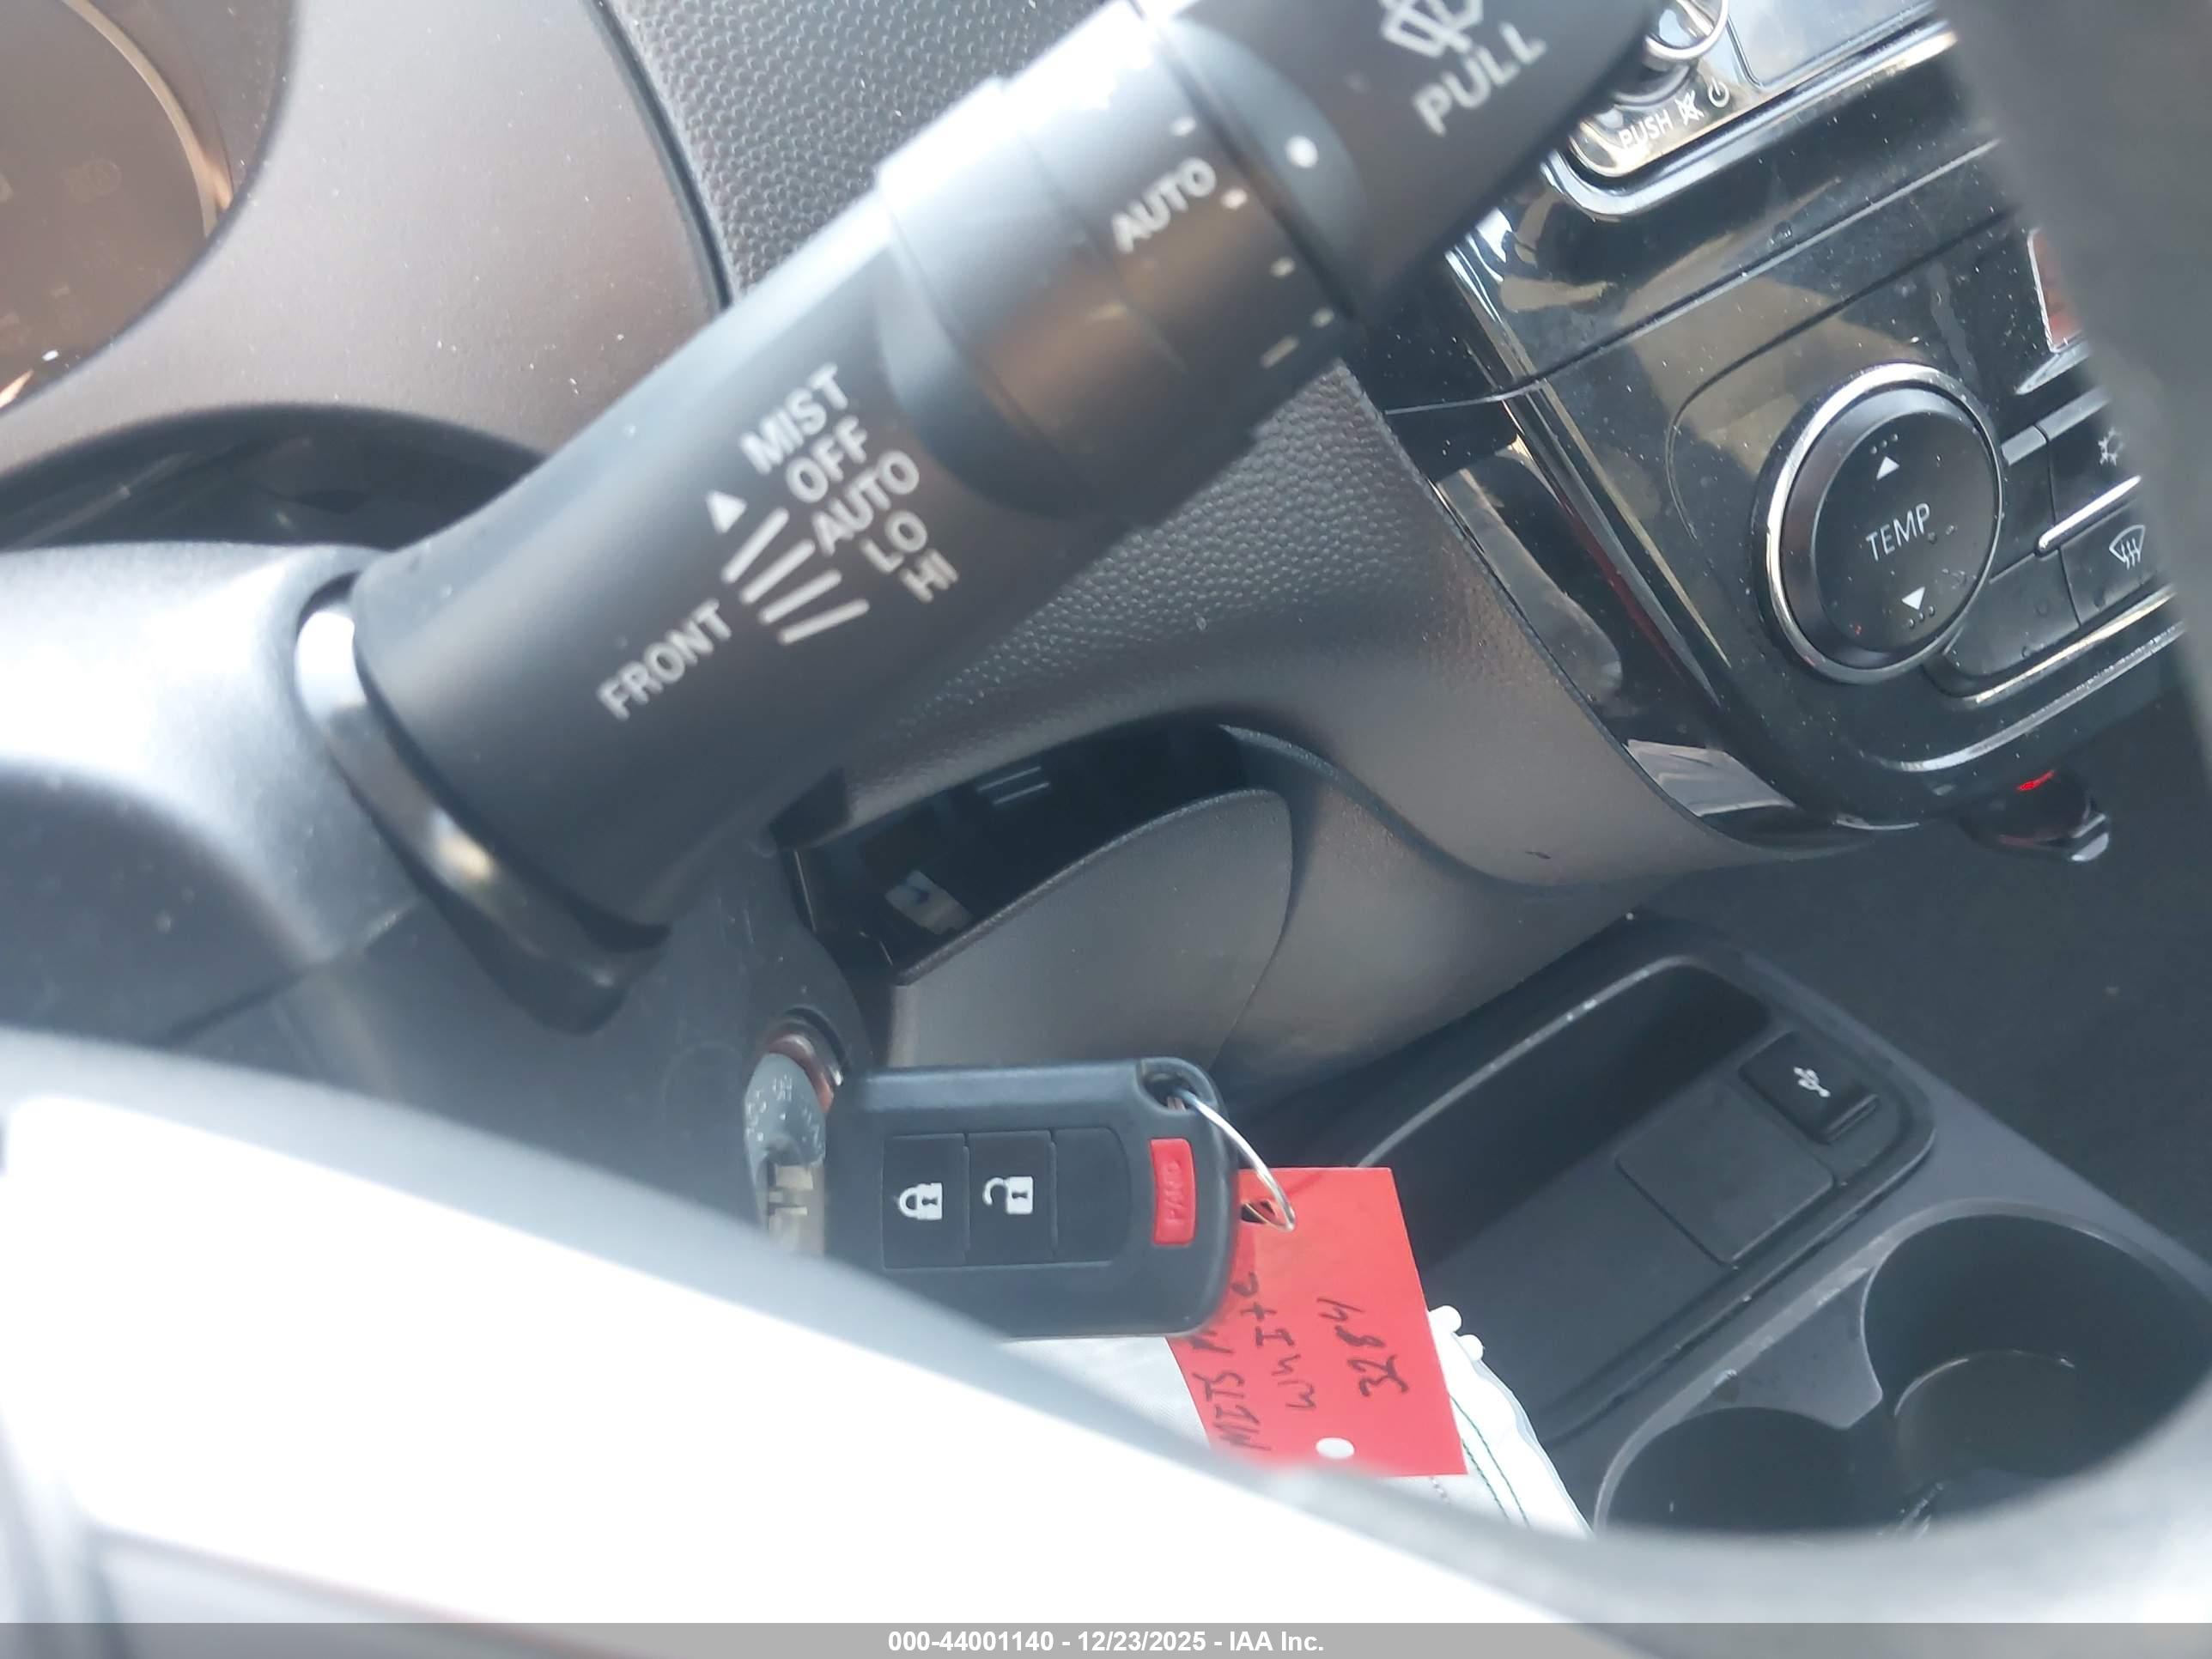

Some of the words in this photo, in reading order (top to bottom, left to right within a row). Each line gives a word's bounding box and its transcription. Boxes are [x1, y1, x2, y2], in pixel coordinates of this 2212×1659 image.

[1413, 22, 1547, 136] PULL
[1619, 114, 1674, 149] PUSH
[1111, 157, 1217, 253] AUTO
[739, 362, 848, 474] MIST
[787, 415, 867, 503] OFF
[812, 451, 920, 556] AUTO
[860, 511, 928, 574] LO
[1865, 502, 1931, 562] TEMP
[902, 549, 959, 603] HI
[597, 599, 732, 721] FRONT
